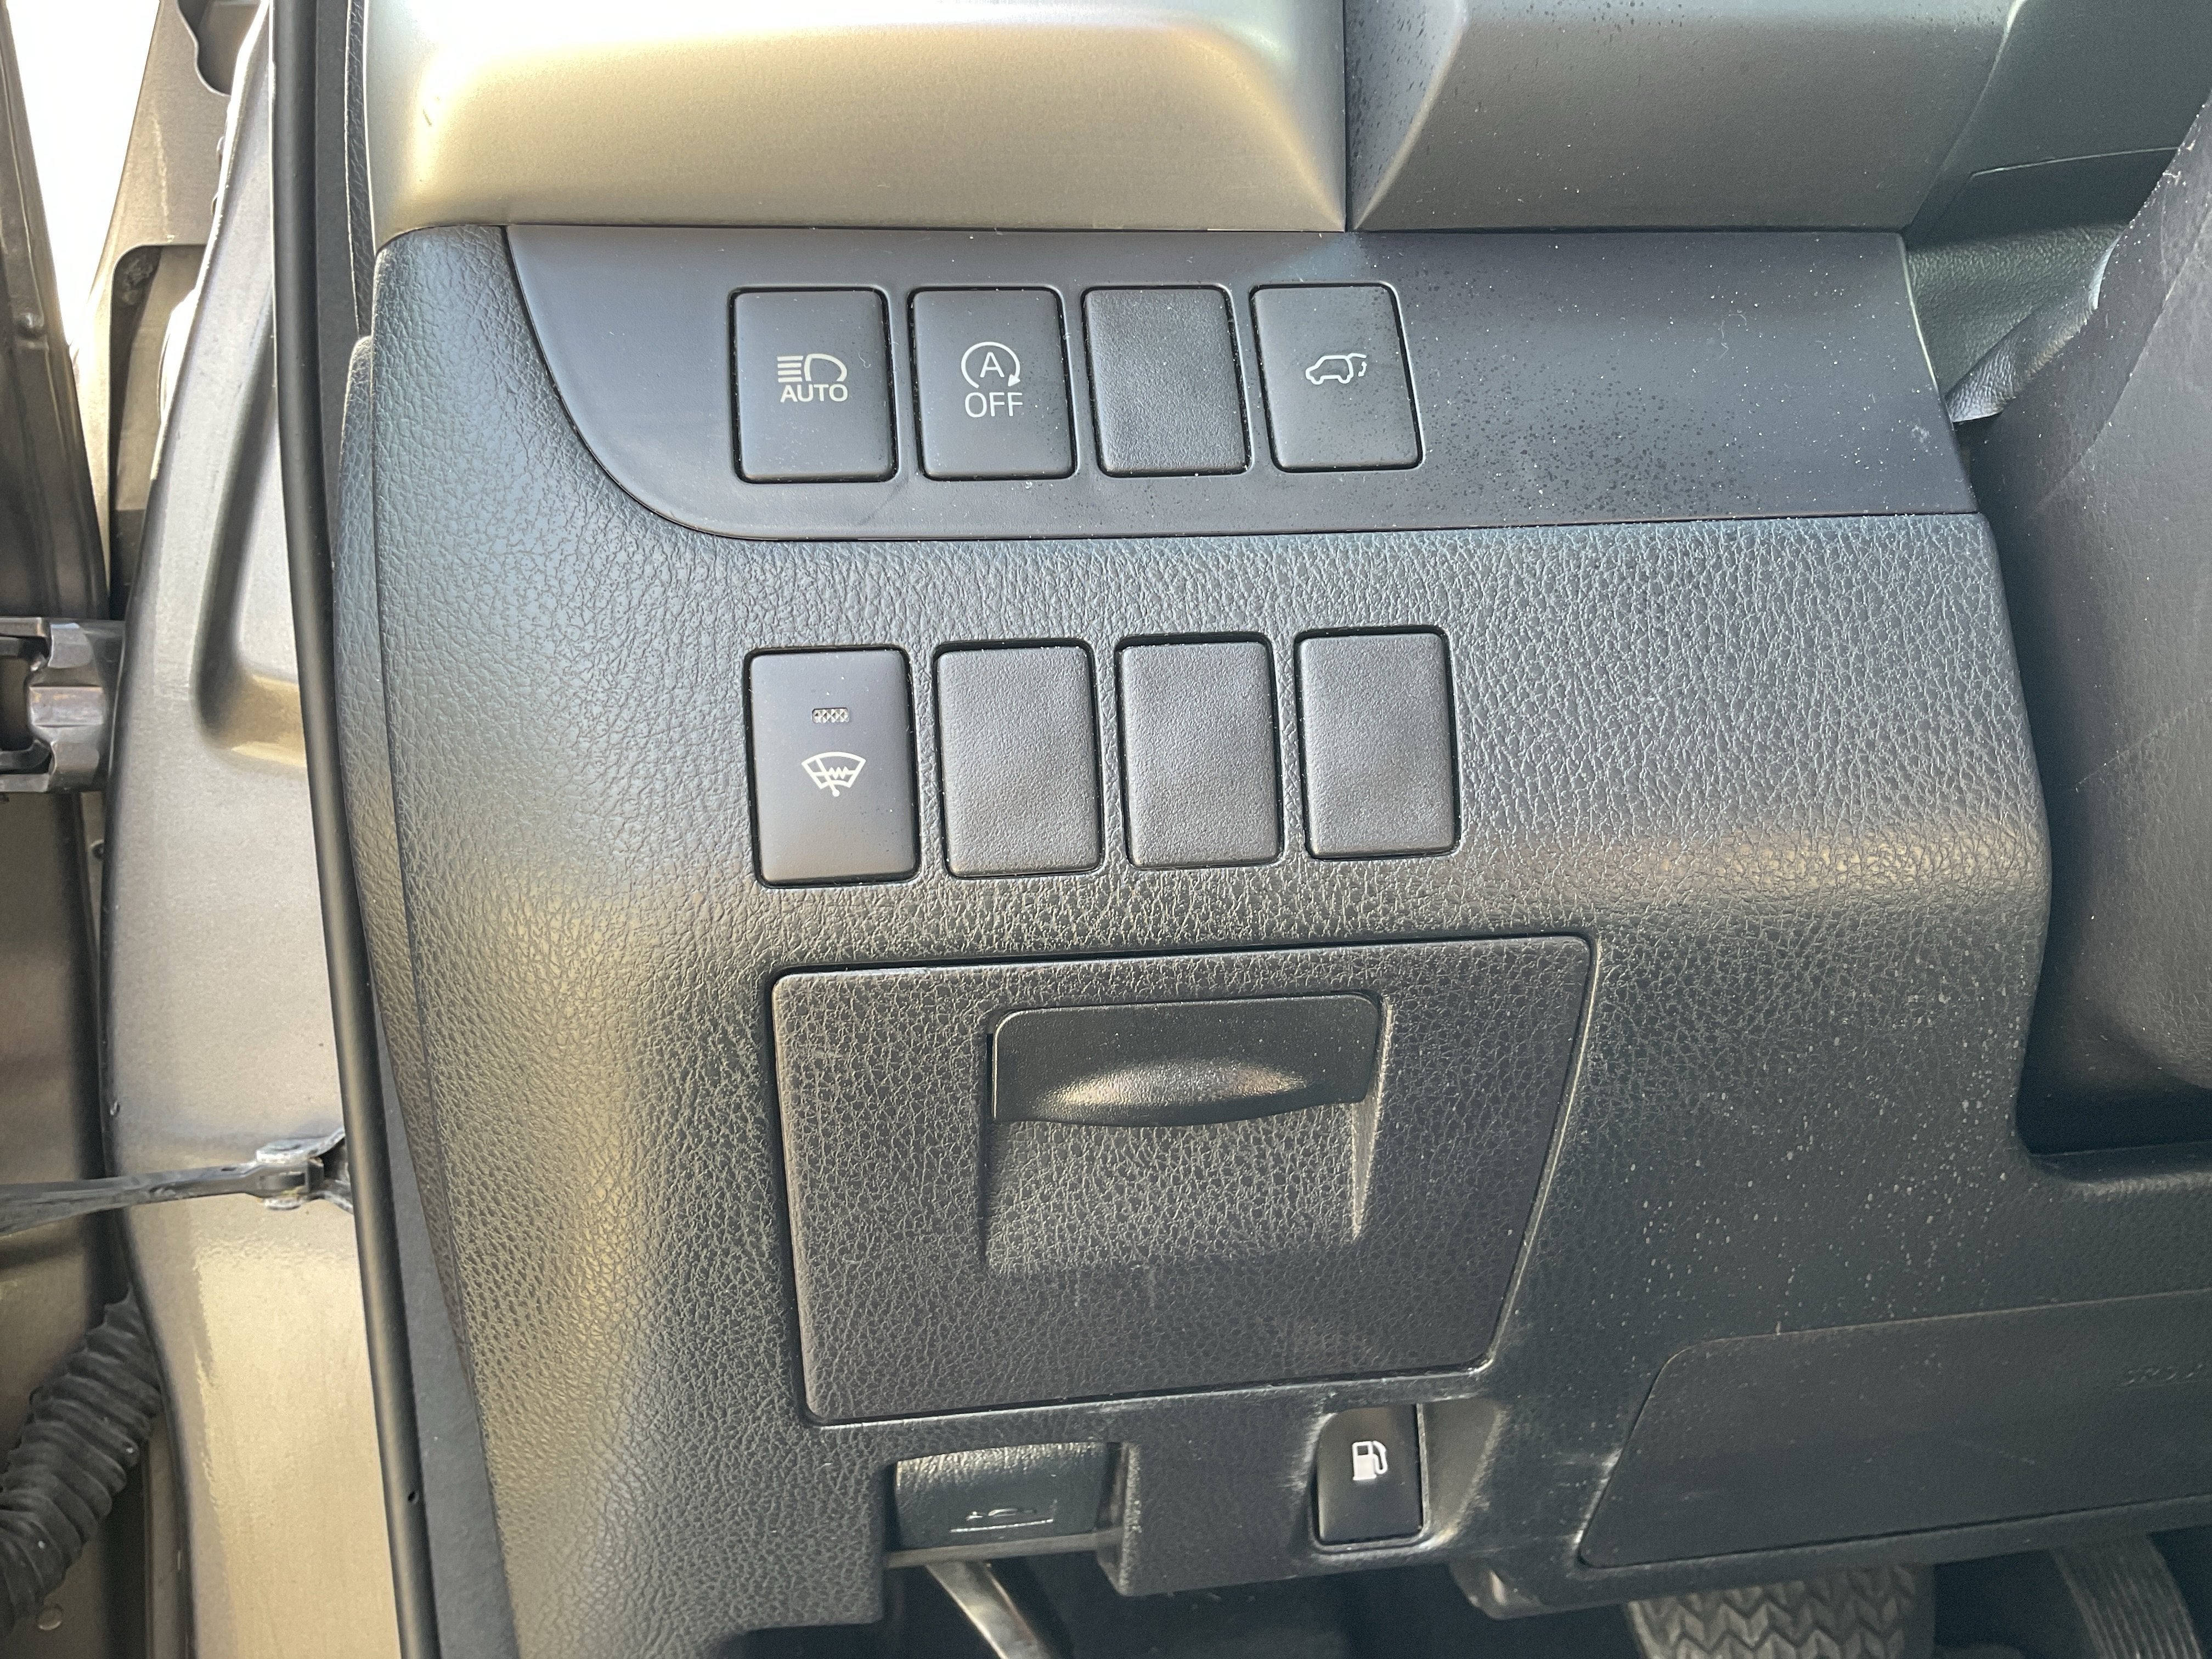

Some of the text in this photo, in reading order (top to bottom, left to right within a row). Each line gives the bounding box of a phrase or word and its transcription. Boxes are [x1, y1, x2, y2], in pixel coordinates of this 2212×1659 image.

[980, 352, 1005, 378] A
[780, 383, 848, 403] AUTO
[964, 392, 1023, 418] OFF
